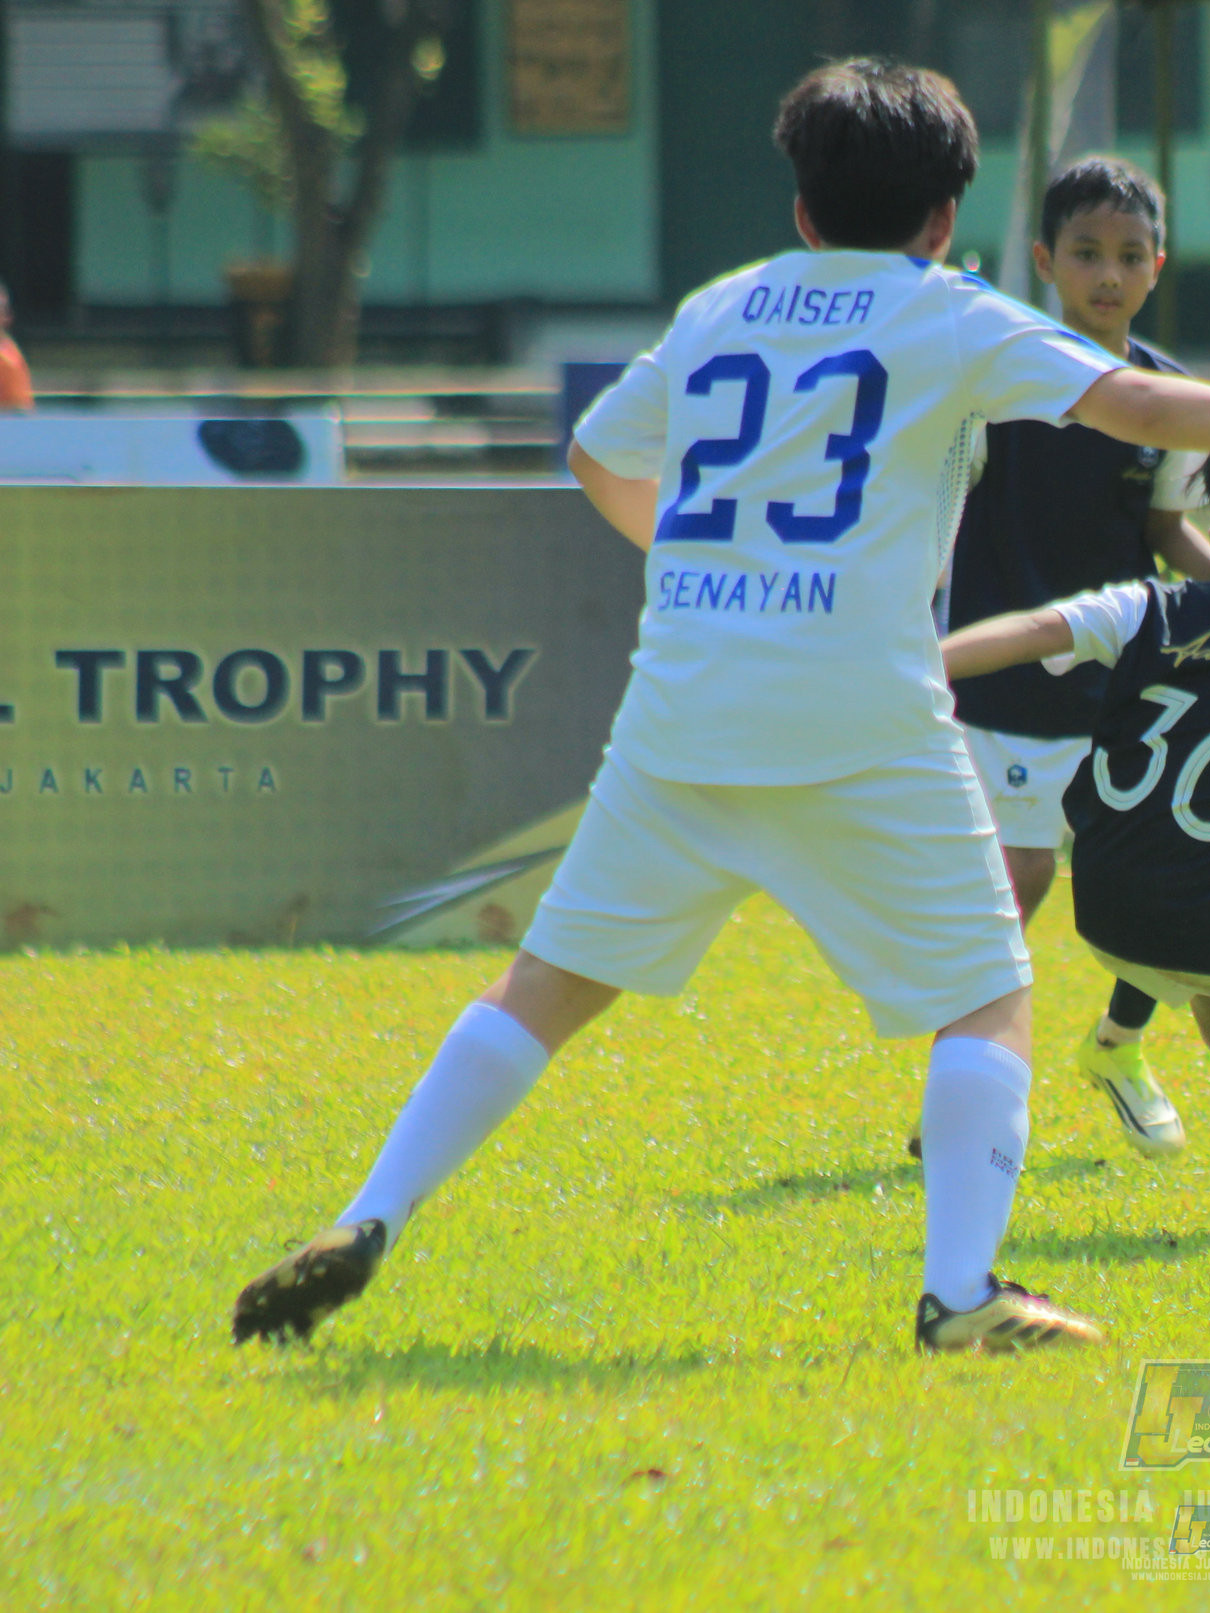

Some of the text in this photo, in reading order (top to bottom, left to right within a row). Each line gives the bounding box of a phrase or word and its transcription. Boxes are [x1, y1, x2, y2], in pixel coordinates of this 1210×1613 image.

[742, 284, 874, 325] QAISER
[654, 349, 888, 543] 23
[658, 571, 836, 614] SENAYAN
[55, 649, 536, 724] TROPHY
[0, 767, 277, 794] JAKARTA
